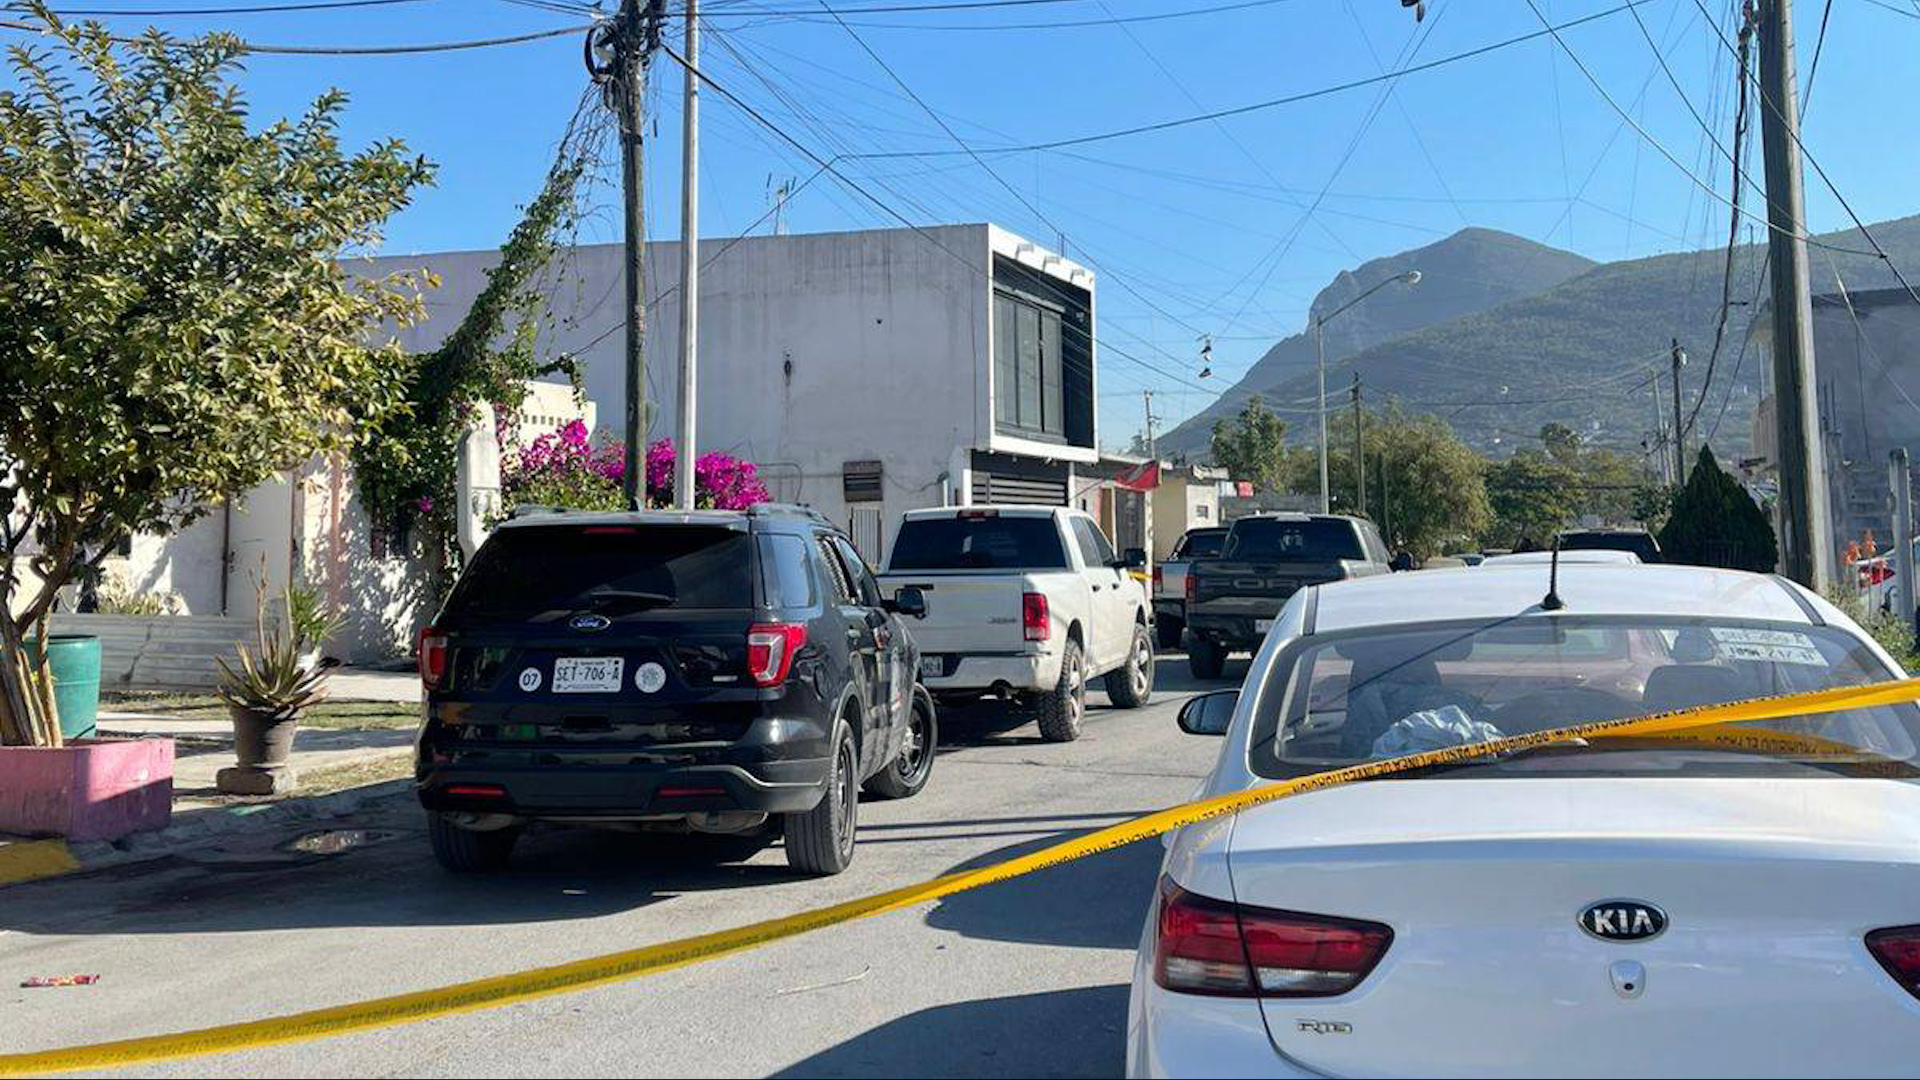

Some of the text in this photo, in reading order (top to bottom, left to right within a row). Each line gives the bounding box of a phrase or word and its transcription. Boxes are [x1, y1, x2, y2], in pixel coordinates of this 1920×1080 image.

[522, 673, 538, 686] 07
[556, 666, 619, 681] SET-706-A
[1592, 908, 1656, 935] KIA
[1295, 1018, 1353, 1035] RIO
